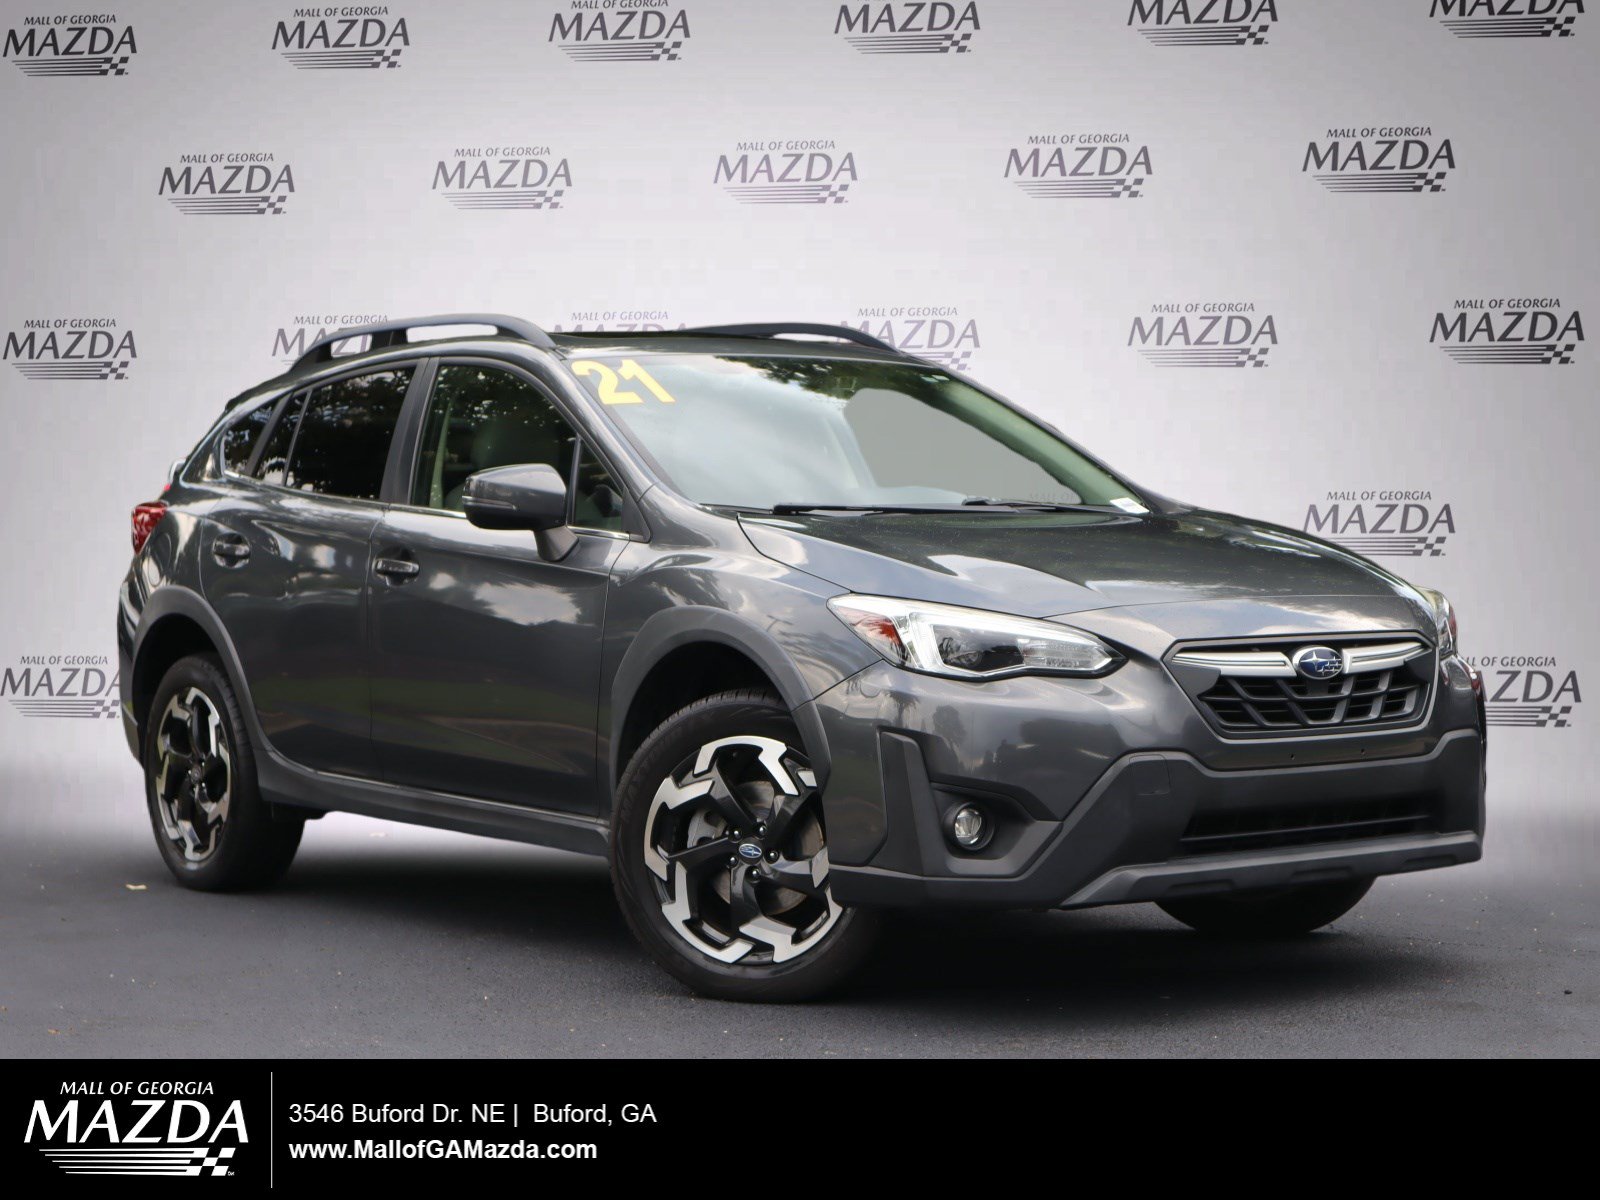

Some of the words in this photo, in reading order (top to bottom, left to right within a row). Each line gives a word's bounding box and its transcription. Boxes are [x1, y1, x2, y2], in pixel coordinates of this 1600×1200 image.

[571, 0, 599, 9] MALL
[603, 0, 617, 9] OF
[294, 7, 321, 17] MALL
[325, 7, 338, 17] OF
[341, 6, 389, 16] GEORGIA
[1128, 0, 1278, 25] MAZDA
[24, 16, 50, 25] MALL
[54, 16, 67, 25] OF
[70, 15, 117, 24] GEORGIA
[835, 1, 980, 34] MAZDA
[549, 9, 690, 42] MAZDA
[272, 18, 410, 49] MAZDA
[3, 26, 137, 57] MAZDA
[1327, 128, 1356, 138] MALL
[1361, 128, 1376, 137] OF
[1379, 127, 1432, 137] GEORGIA
[1027, 135, 1056, 144] MALL
[1061, 135, 1075, 144] OF
[1079, 134, 1130, 144] GEORGIA
[736, 141, 764, 151] MALL
[768, 141, 783, 150] OF
[786, 140, 835, 150] GEORGIA
[454, 147, 482, 157] MALL
[486, 147, 499, 157] OF
[502, 146, 551, 156] GEORGIA
[1302, 139, 1455, 171] MAZDA
[180, 154, 207, 163] MALL
[211, 154, 224, 163] OF
[227, 152, 274, 162] GEORGIA
[1004, 146, 1153, 177] MAZDA
[714, 152, 858, 183] MAZDA
[432, 158, 573, 189] MAZDA
[158, 165, 295, 195] MAZDA
[1151, 304, 1180, 313] MALL
[1185, 303, 1200, 313] OF
[1203, 303, 1255, 313] GEORGIA
[1454, 299, 1484, 309] MALL
[1489, 299, 1504, 309] OF
[1507, 298, 1561, 308] GEORGIA
[571, 312, 599, 321] MALL
[603, 311, 617, 321] OF
[620, 311, 669, 320] GEORGIA
[857, 308, 886, 317] MALL
[890, 307, 905, 317] OF
[908, 307, 958, 316] GEORGIA
[24, 320, 50, 328] MALL
[54, 319, 67, 328] OF
[70, 319, 117, 328] GEORGIA
[294, 316, 321, 325] MALL
[325, 315, 338, 325] OF
[341, 315, 388, 325] GEORGIA
[1128, 315, 1279, 345] MAZDA
[1430, 311, 1585, 342] MAZDA
[3, 331, 137, 360] MAZDA
[571, 359, 675, 405] 21
[1327, 491, 1356, 501] MALL
[1361, 491, 1376, 501] OF
[1379, 490, 1432, 501] GEORGIA
[1303, 504, 1456, 534] MAZDA
[20, 656, 46, 665] MALL
[49, 656, 61, 665] OF
[64, 656, 108, 665] GEORGIA
[1481, 656, 1498, 667] OF
[1500, 656, 1557, 667] GEORGIA
[1476, 670, 1582, 703] ZDA
